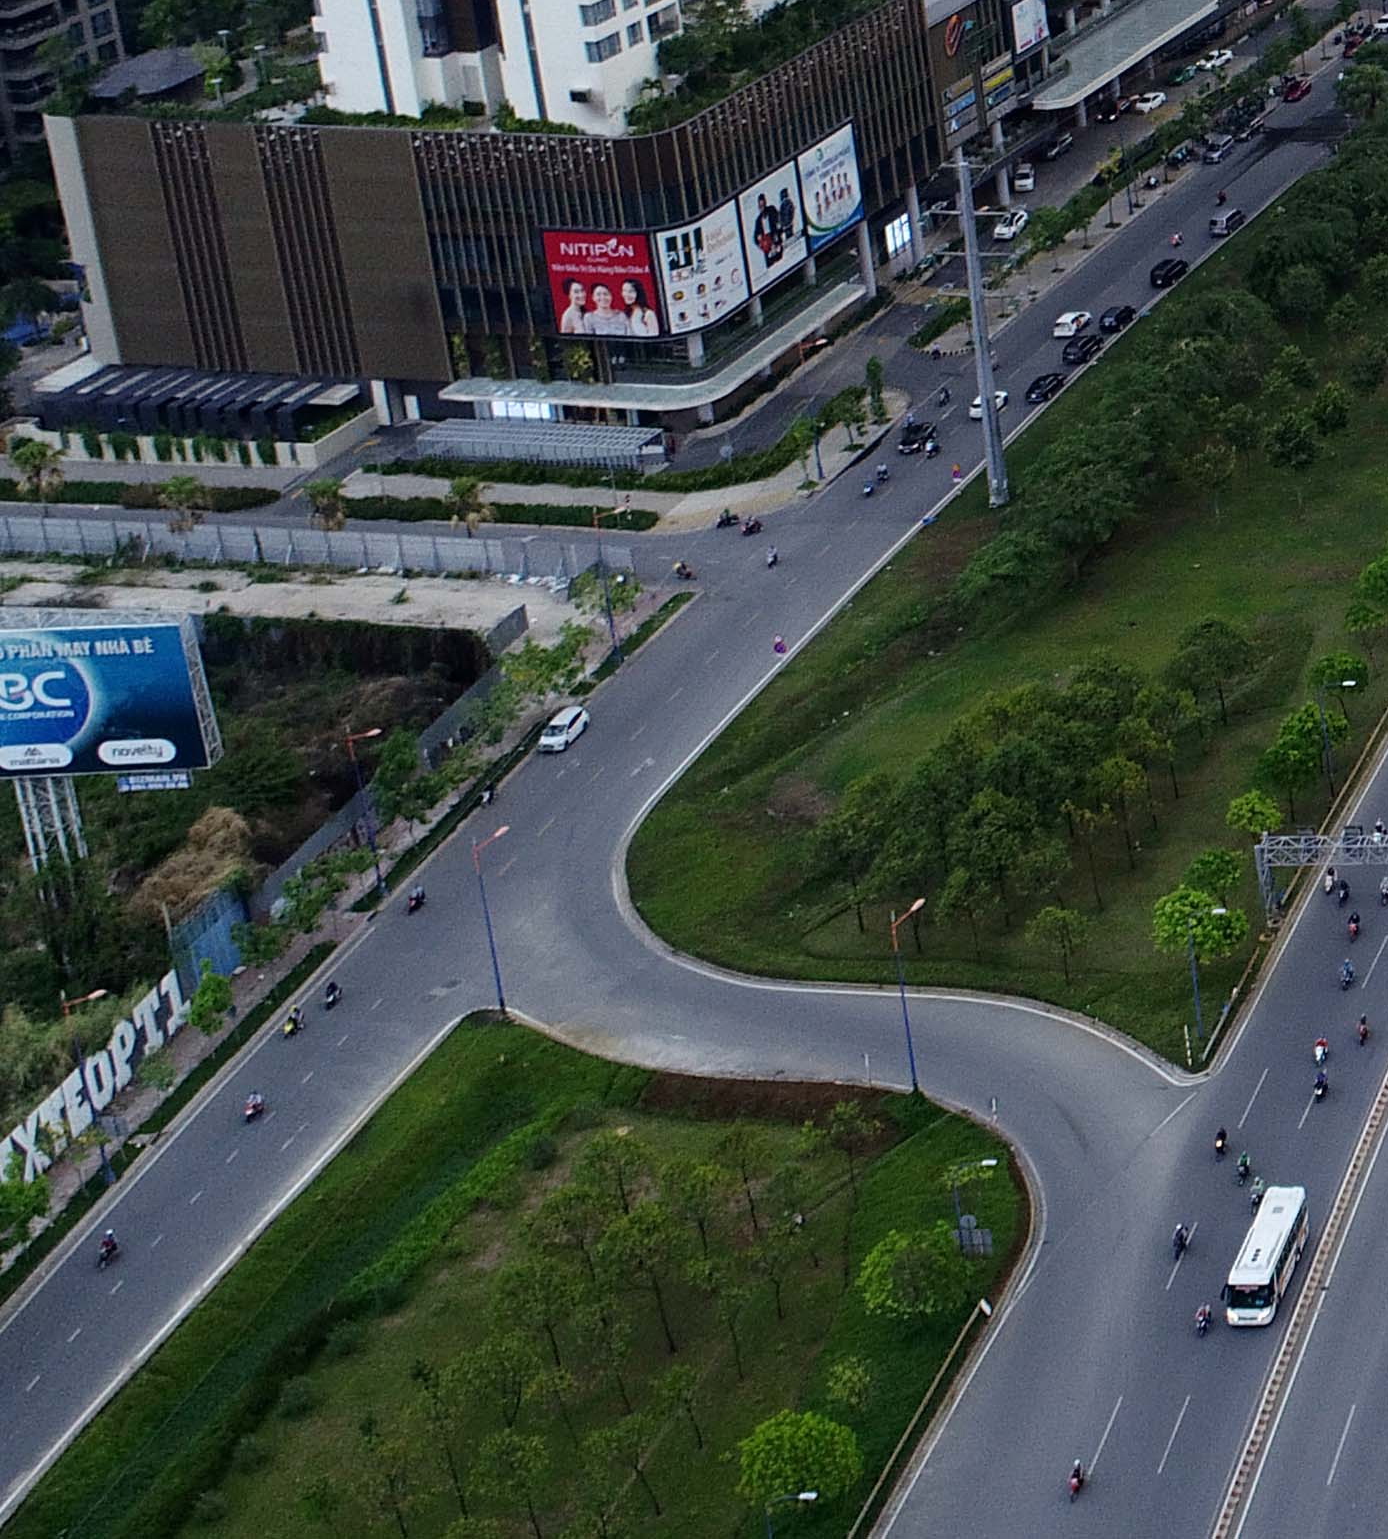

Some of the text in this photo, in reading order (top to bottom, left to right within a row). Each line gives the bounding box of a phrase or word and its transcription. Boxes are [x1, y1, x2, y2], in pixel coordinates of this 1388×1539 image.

[560, 241, 635, 258] NITIPON
[57, 641, 91, 658] MAY
[112, 743, 163, 758] novelty
